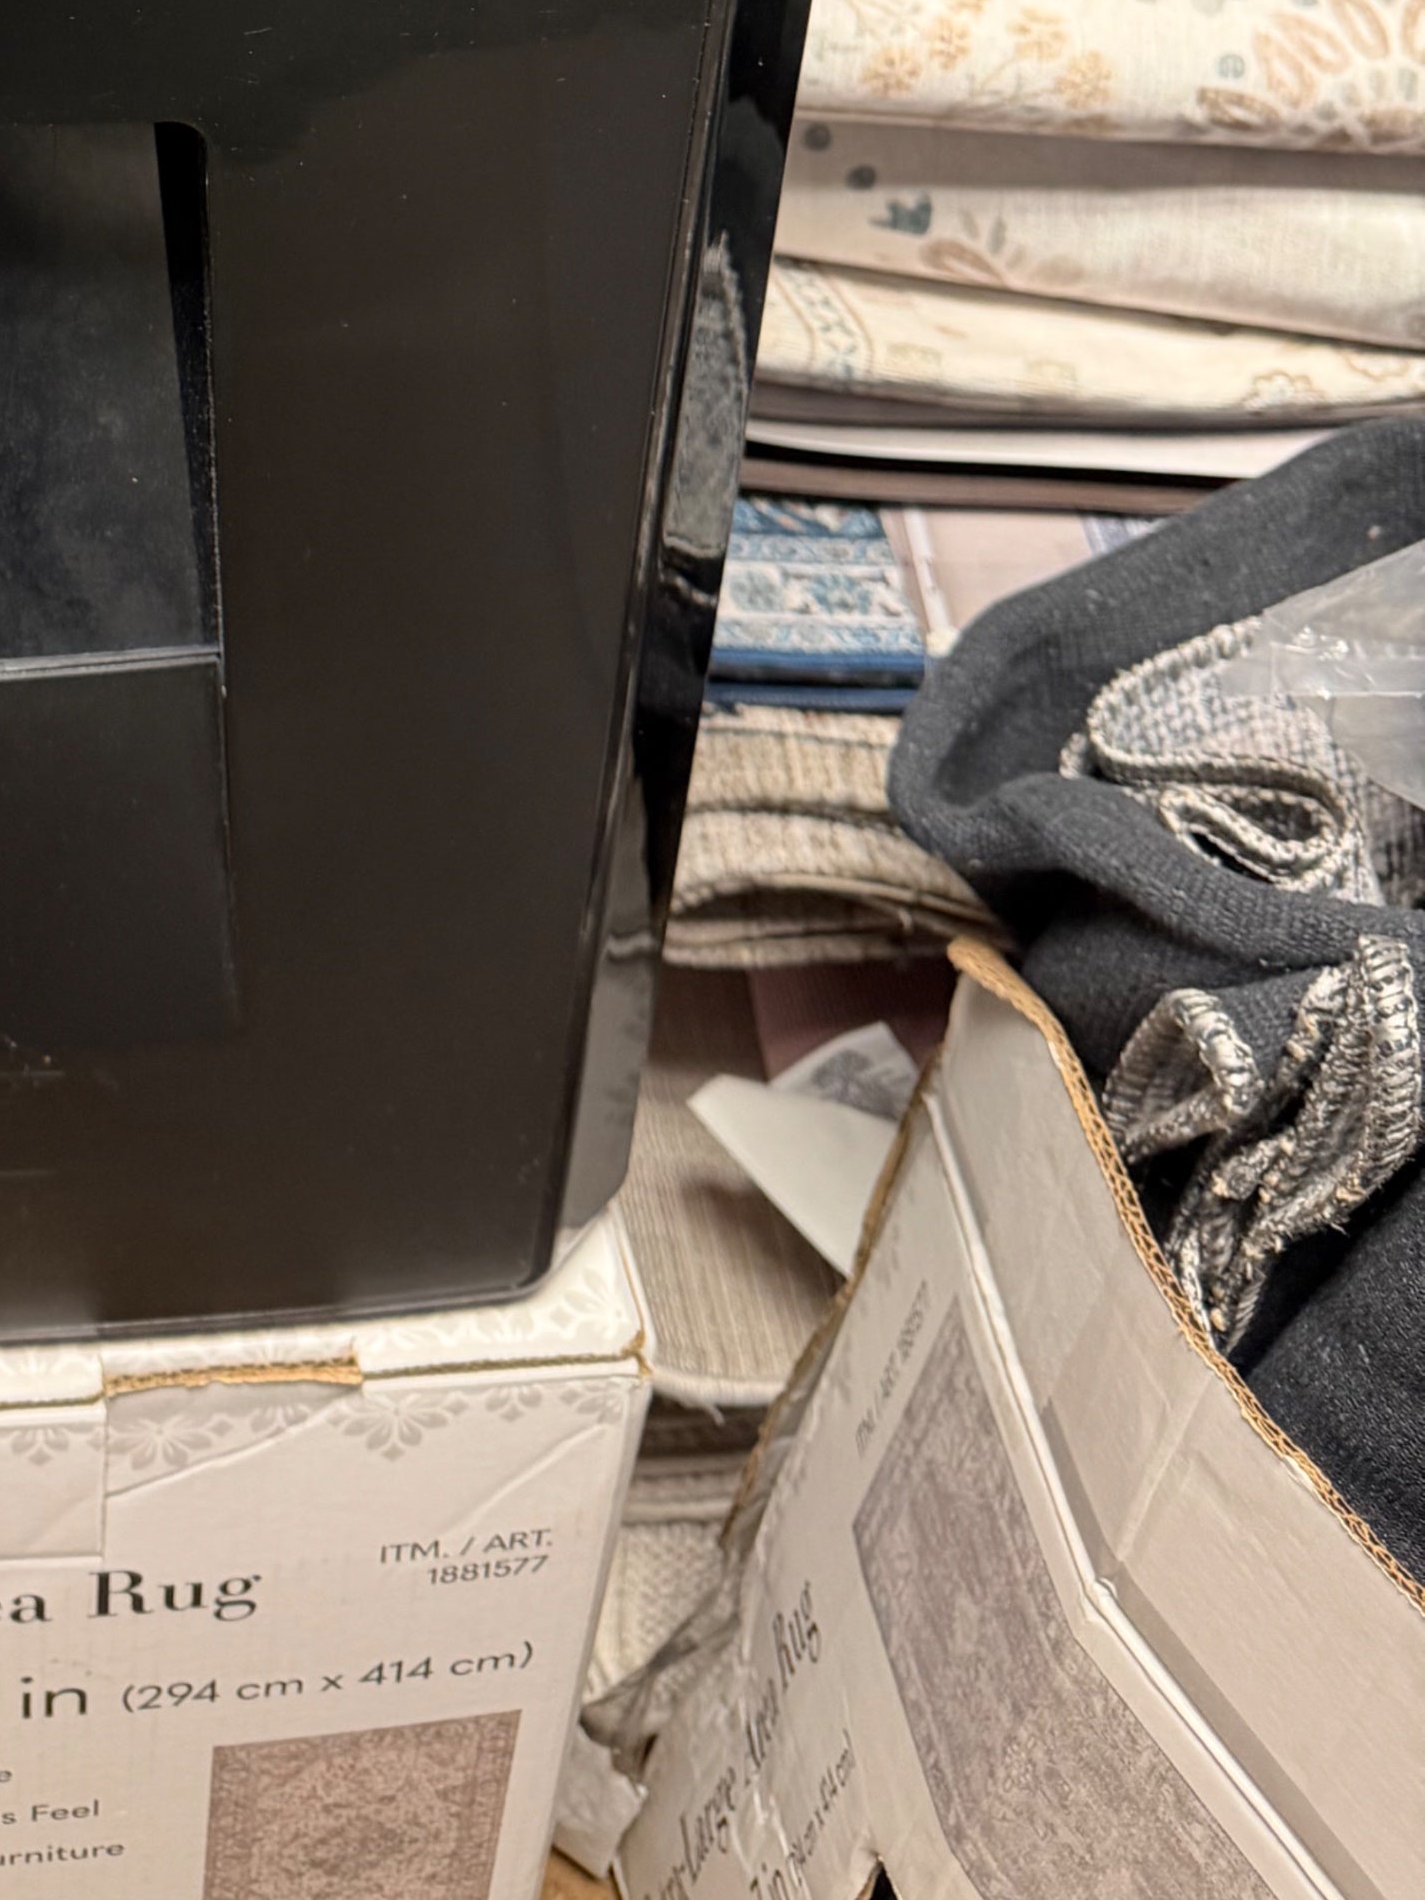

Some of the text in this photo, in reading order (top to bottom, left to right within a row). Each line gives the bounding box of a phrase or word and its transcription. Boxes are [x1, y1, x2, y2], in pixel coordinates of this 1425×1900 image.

[380, 1528, 553, 1564] ITM. / ART.
[428, 1554, 550, 1586] 1881577
[87, 1569, 263, 1622] Rug
[21, 1676, 88, 1719] in
[122, 1679, 221, 1713] (294
[236, 1677, 304, 1701] cm
[320, 1673, 344, 1692] x
[359, 1656, 434, 1686] 414
[450, 1641, 534, 1677] cm)
[31, 1799, 100, 1823] Feel
